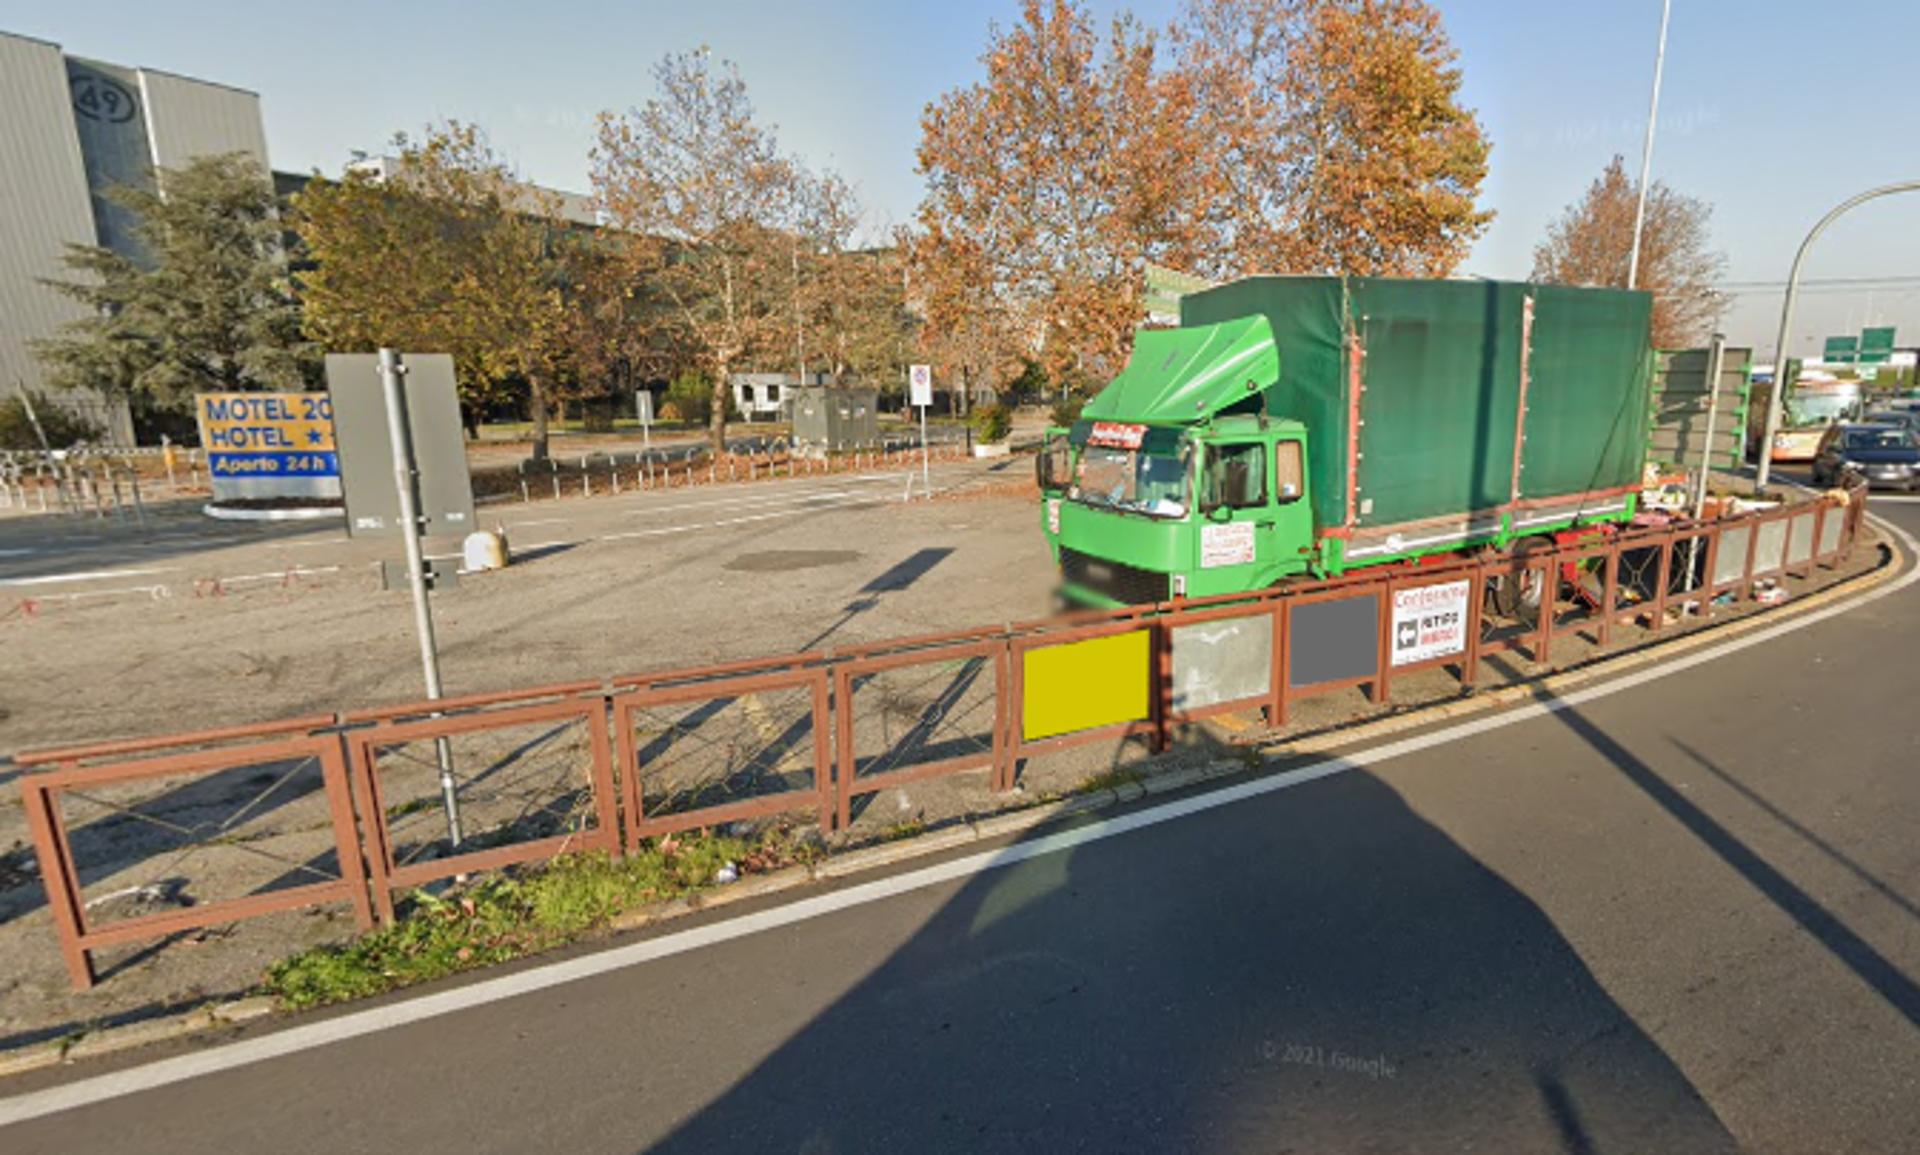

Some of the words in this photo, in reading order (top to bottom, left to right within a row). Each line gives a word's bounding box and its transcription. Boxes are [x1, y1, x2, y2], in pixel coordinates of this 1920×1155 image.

[80, 85, 120, 115] 49
[204, 398, 295, 420] MOTEL
[210, 426, 294, 447] HOTEL
[286, 455, 309, 471] 24
